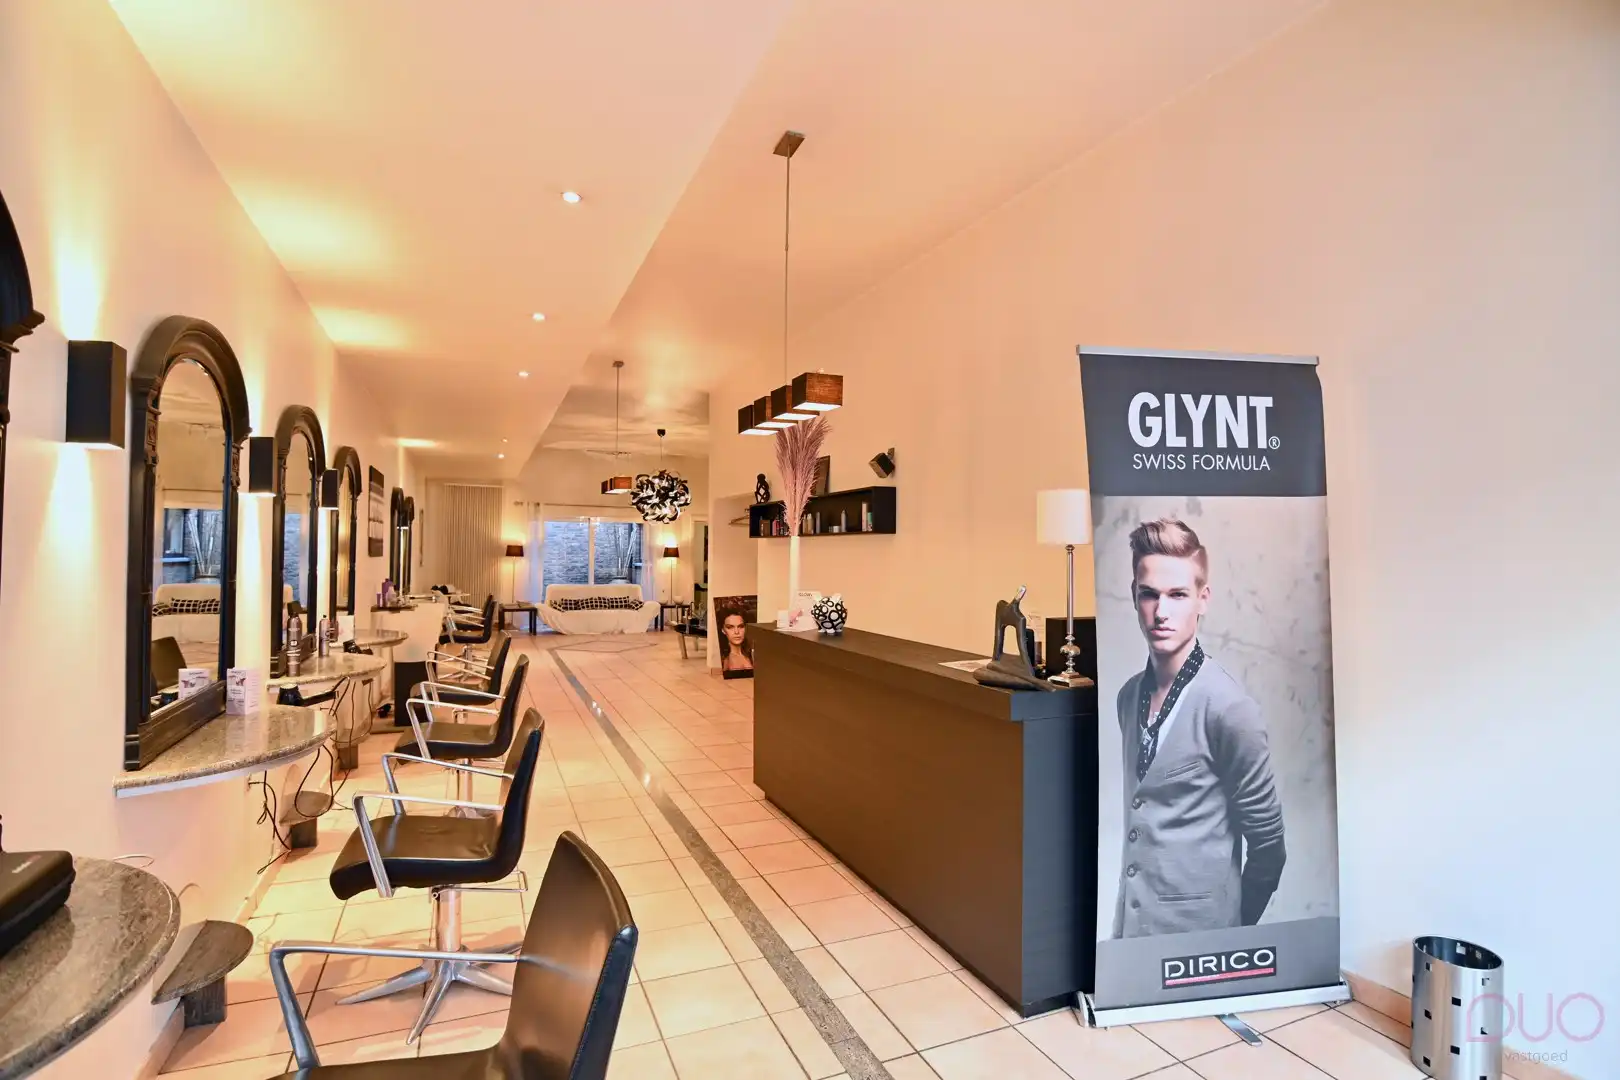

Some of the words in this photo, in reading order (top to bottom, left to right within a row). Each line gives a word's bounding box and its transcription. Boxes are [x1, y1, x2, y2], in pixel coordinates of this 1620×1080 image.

[1132, 453, 1187, 470] SWISS
[1192, 454, 1271, 471] FORMULA
[1164, 949, 1274, 978] DIRICO
